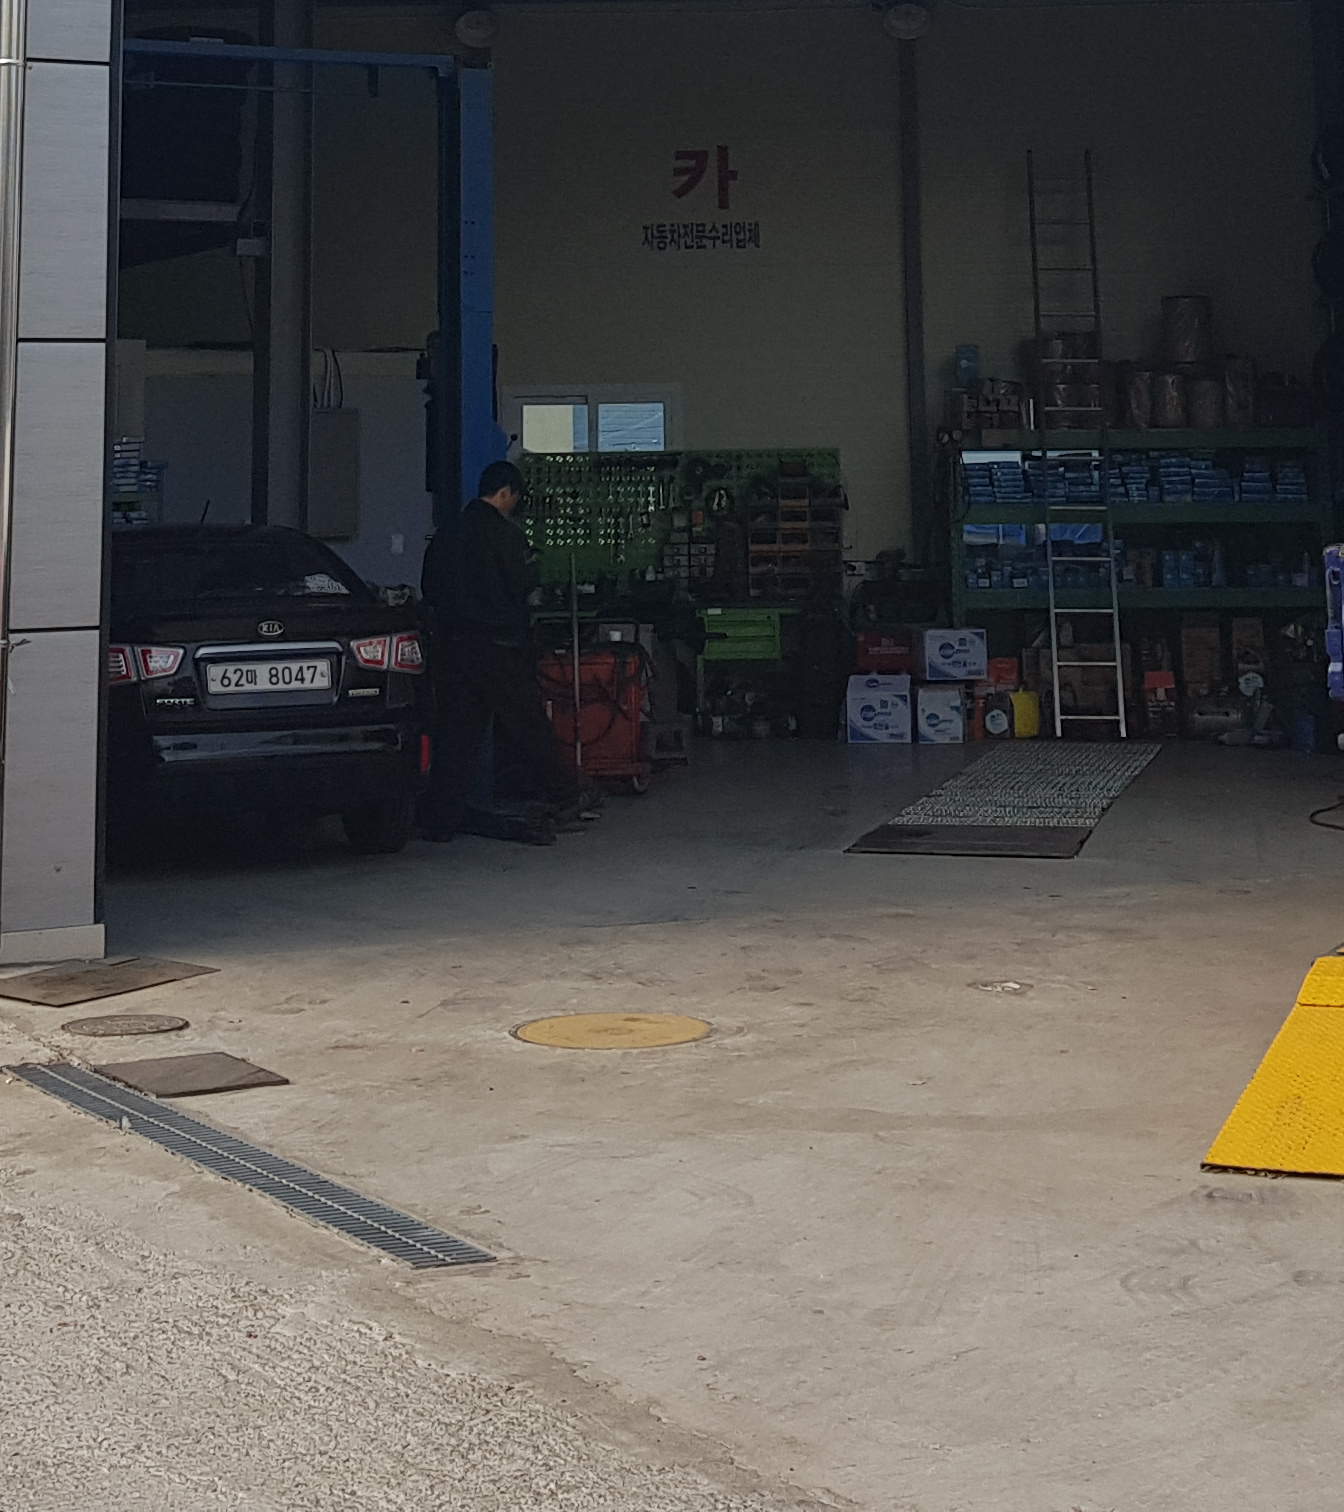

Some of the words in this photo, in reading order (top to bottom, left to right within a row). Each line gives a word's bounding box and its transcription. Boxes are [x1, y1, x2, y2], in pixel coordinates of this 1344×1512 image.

[671, 145, 738, 209] 카
[641, 221, 761, 251] 자동차전문수리업체
[260, 623, 280, 633] KIA
[219, 667, 258, 688] 62마
[268, 665, 318, 686] 8047
